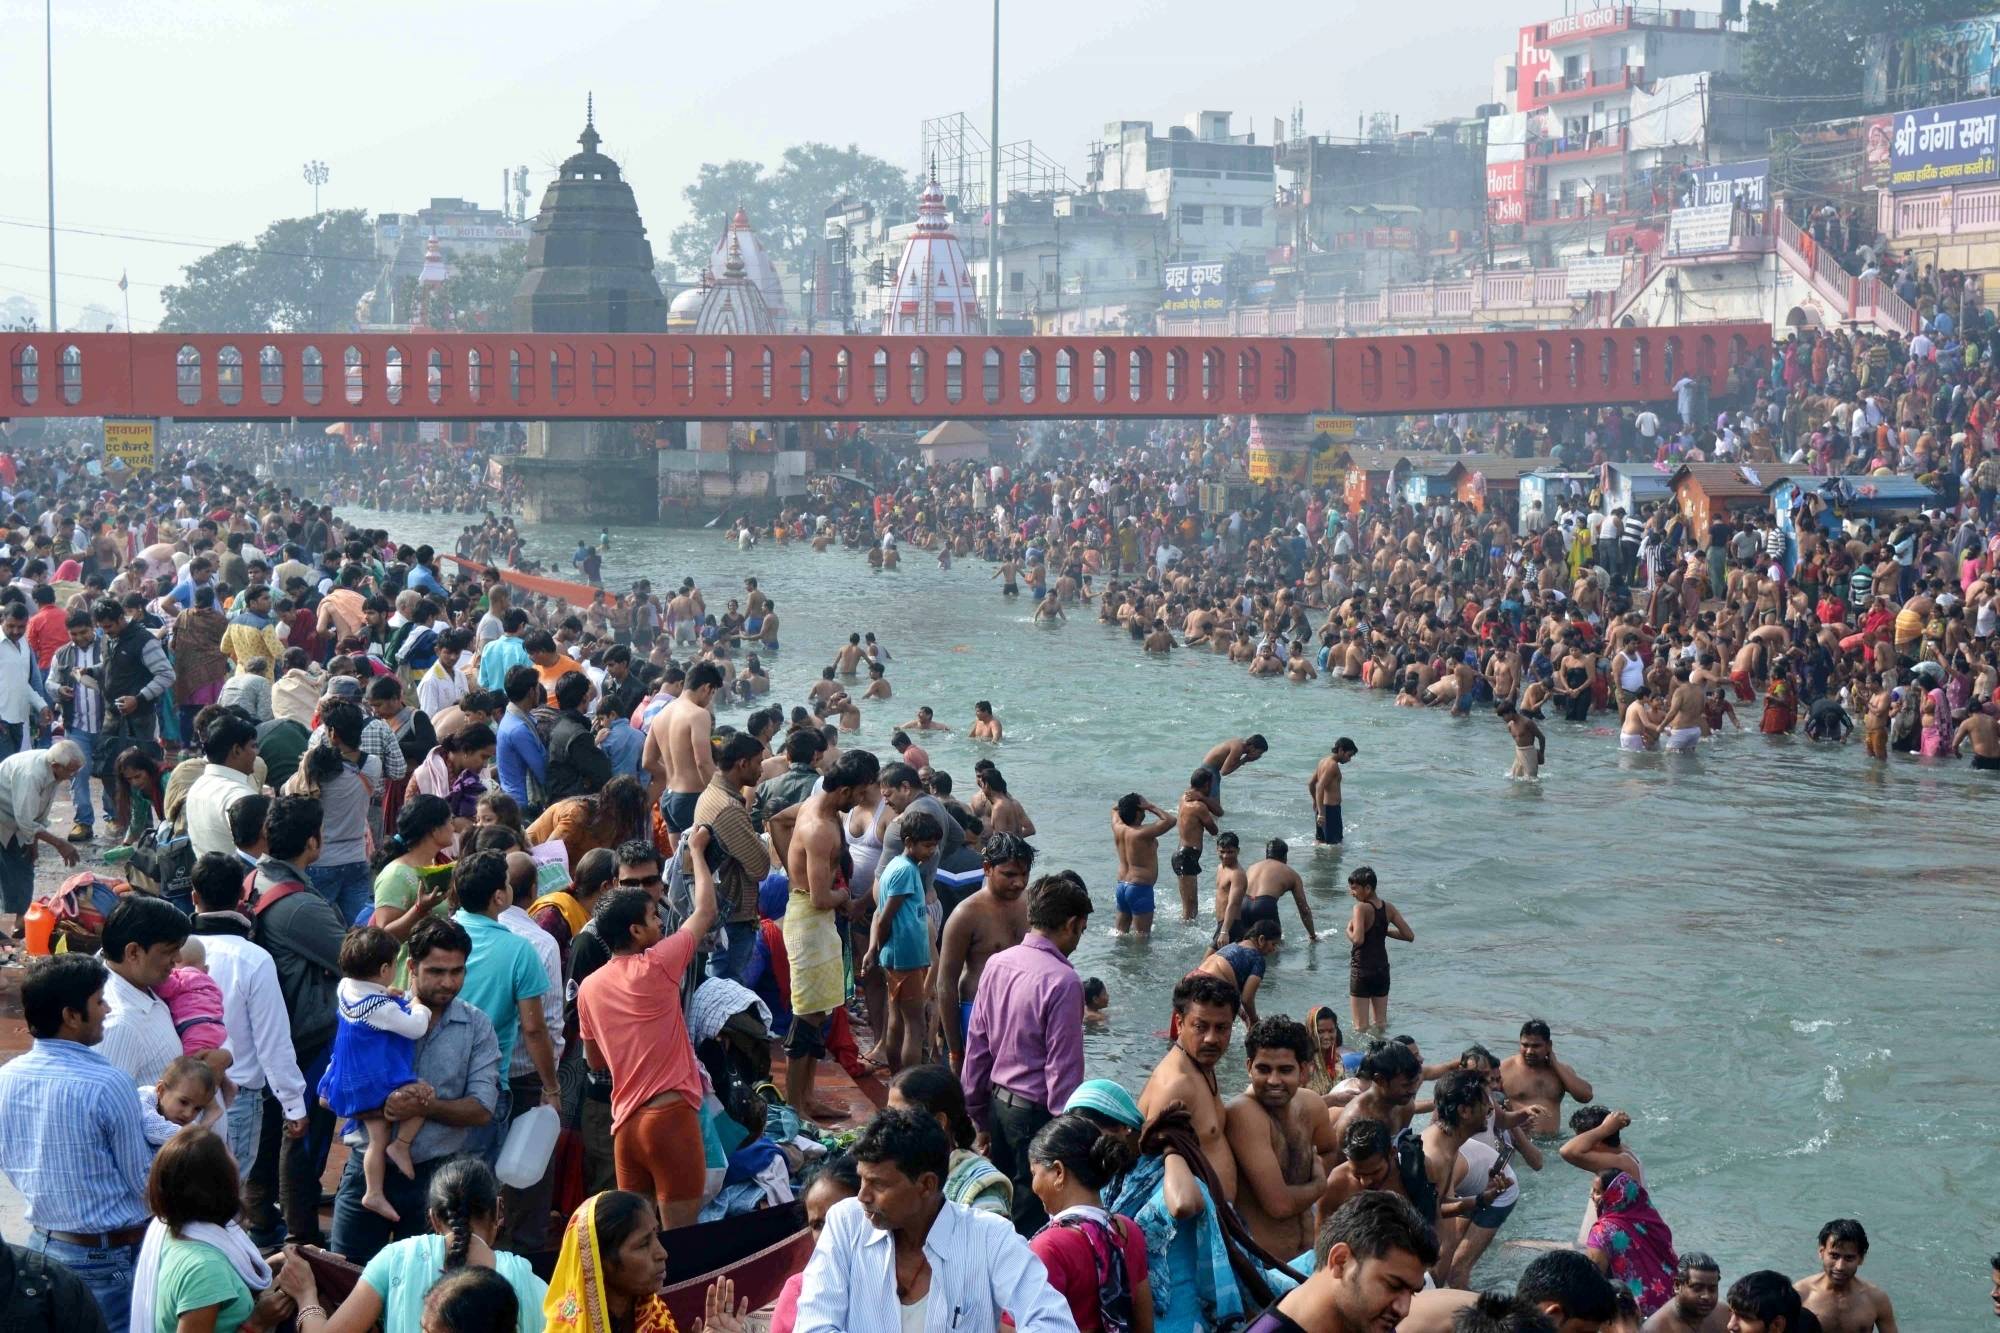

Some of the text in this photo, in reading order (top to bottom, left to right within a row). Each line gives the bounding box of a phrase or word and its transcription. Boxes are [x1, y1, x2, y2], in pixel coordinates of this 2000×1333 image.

[1549, 9, 1613, 37] HOTEL OSHO
[1894, 112, 1997, 156] श्री गंगा सभा
[1191, 264, 1224, 296] कुण्ड
